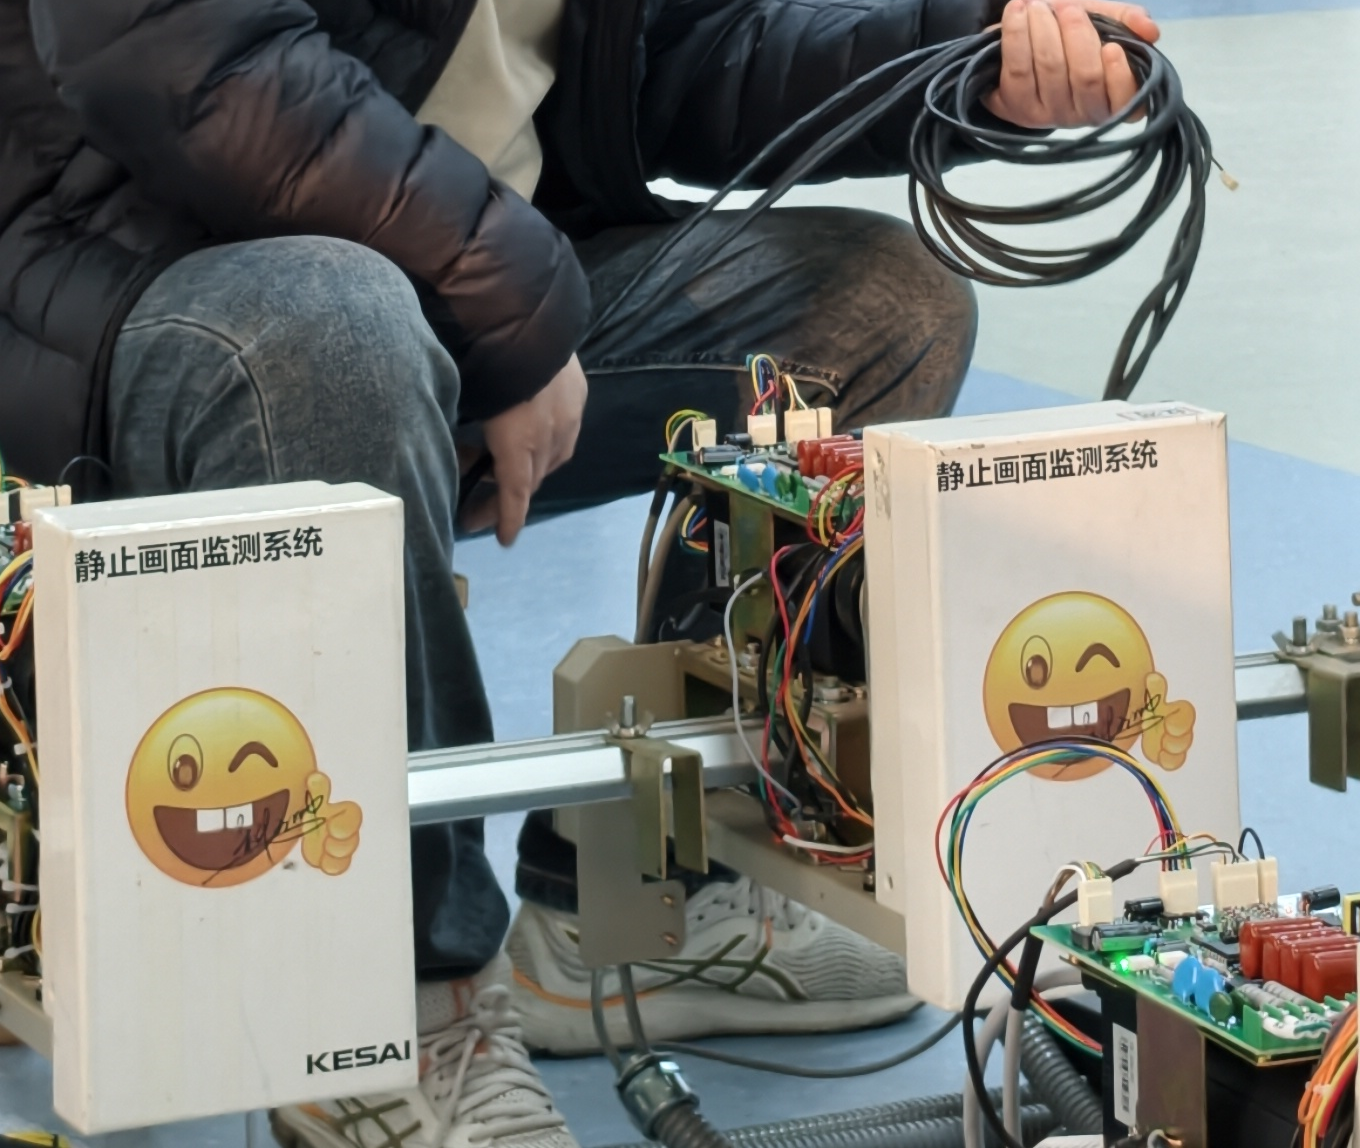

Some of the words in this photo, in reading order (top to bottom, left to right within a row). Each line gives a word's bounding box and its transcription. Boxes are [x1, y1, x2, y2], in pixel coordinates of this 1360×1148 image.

[936, 439, 1158, 492] 静止画面监测系统
[74, 526, 324, 583] 静止画面监测系统
[306, 1039, 410, 1074] KESAI
